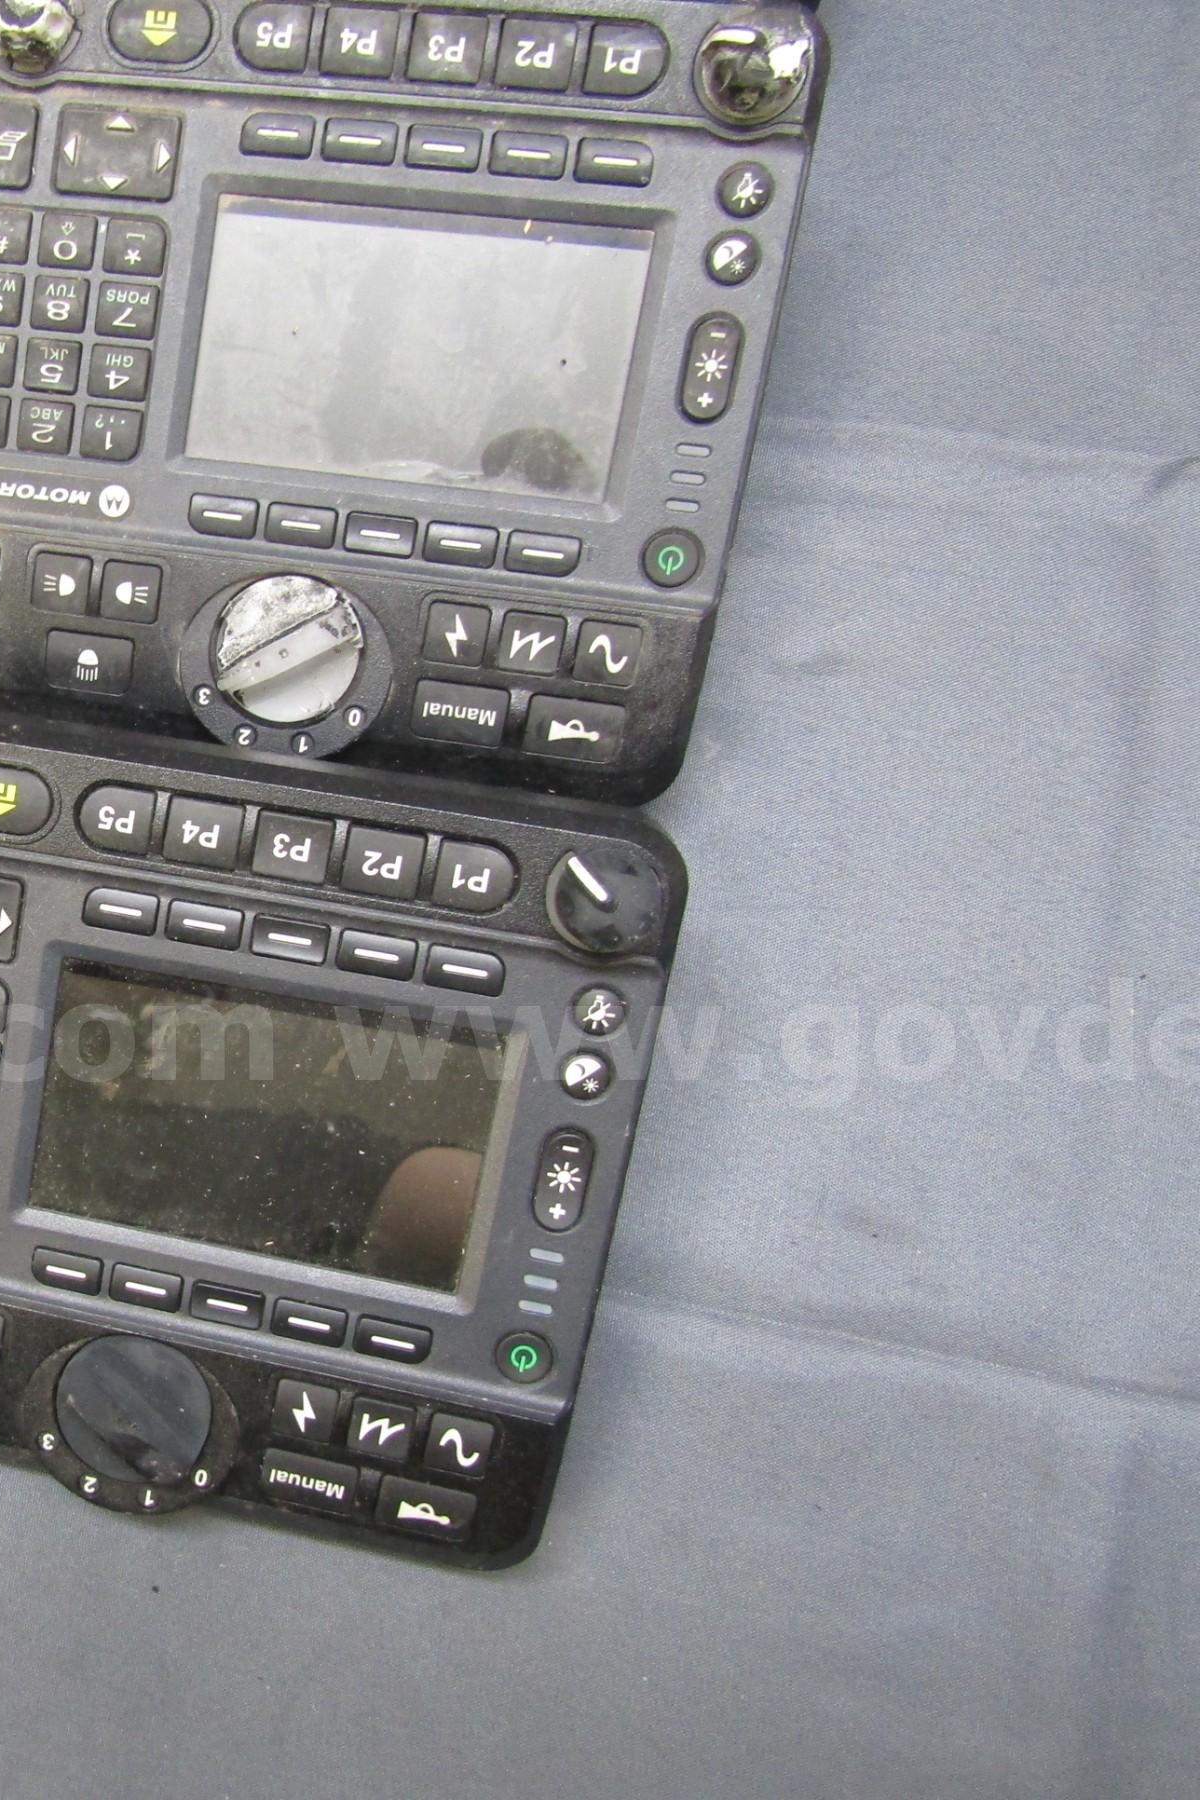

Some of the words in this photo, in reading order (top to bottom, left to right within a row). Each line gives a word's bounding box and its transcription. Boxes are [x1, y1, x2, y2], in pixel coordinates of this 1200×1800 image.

[256, 22, 293, 49] P5
[340, 28, 377, 55] P4
[428, 35, 466, 62] P3
[515, 41, 555, 68] P2
[604, 48, 642, 74] P1
[54, 240, 77, 260] 0
[45, 284, 76, 297] TUV
[106, 289, 150, 304] PQRS
[47, 301, 70, 320] 8
[111, 307, 137, 327] 7
[40, 346, 69, 361] JKL
[106, 353, 134, 367] GHI
[40, 364, 63, 383] 5
[105, 370, 130, 390] 4
[30, 407, 63, 420] ABC
[32, 423, 55, 443] 2
[105, 431, 113, 450] 1
[199, 689, 211, 704] 3
[348, 710, 362, 727] 0
[422, 701, 497, 727] Manual
[238, 728, 251, 744] 2
[299, 735, 308, 753] 1
[98, 805, 135, 833] P5
[182, 820, 220, 848] P4
[273, 833, 312, 862] P3
[362, 850, 402, 879] P2
[452, 864, 490, 893] P1
[42, 1433, 55, 1450] 3
[84, 1476, 96, 1493] 2
[195, 1470, 207, 1487] 0
[269, 1468, 345, 1499] Manual
[144, 1490, 154, 1507] 1
